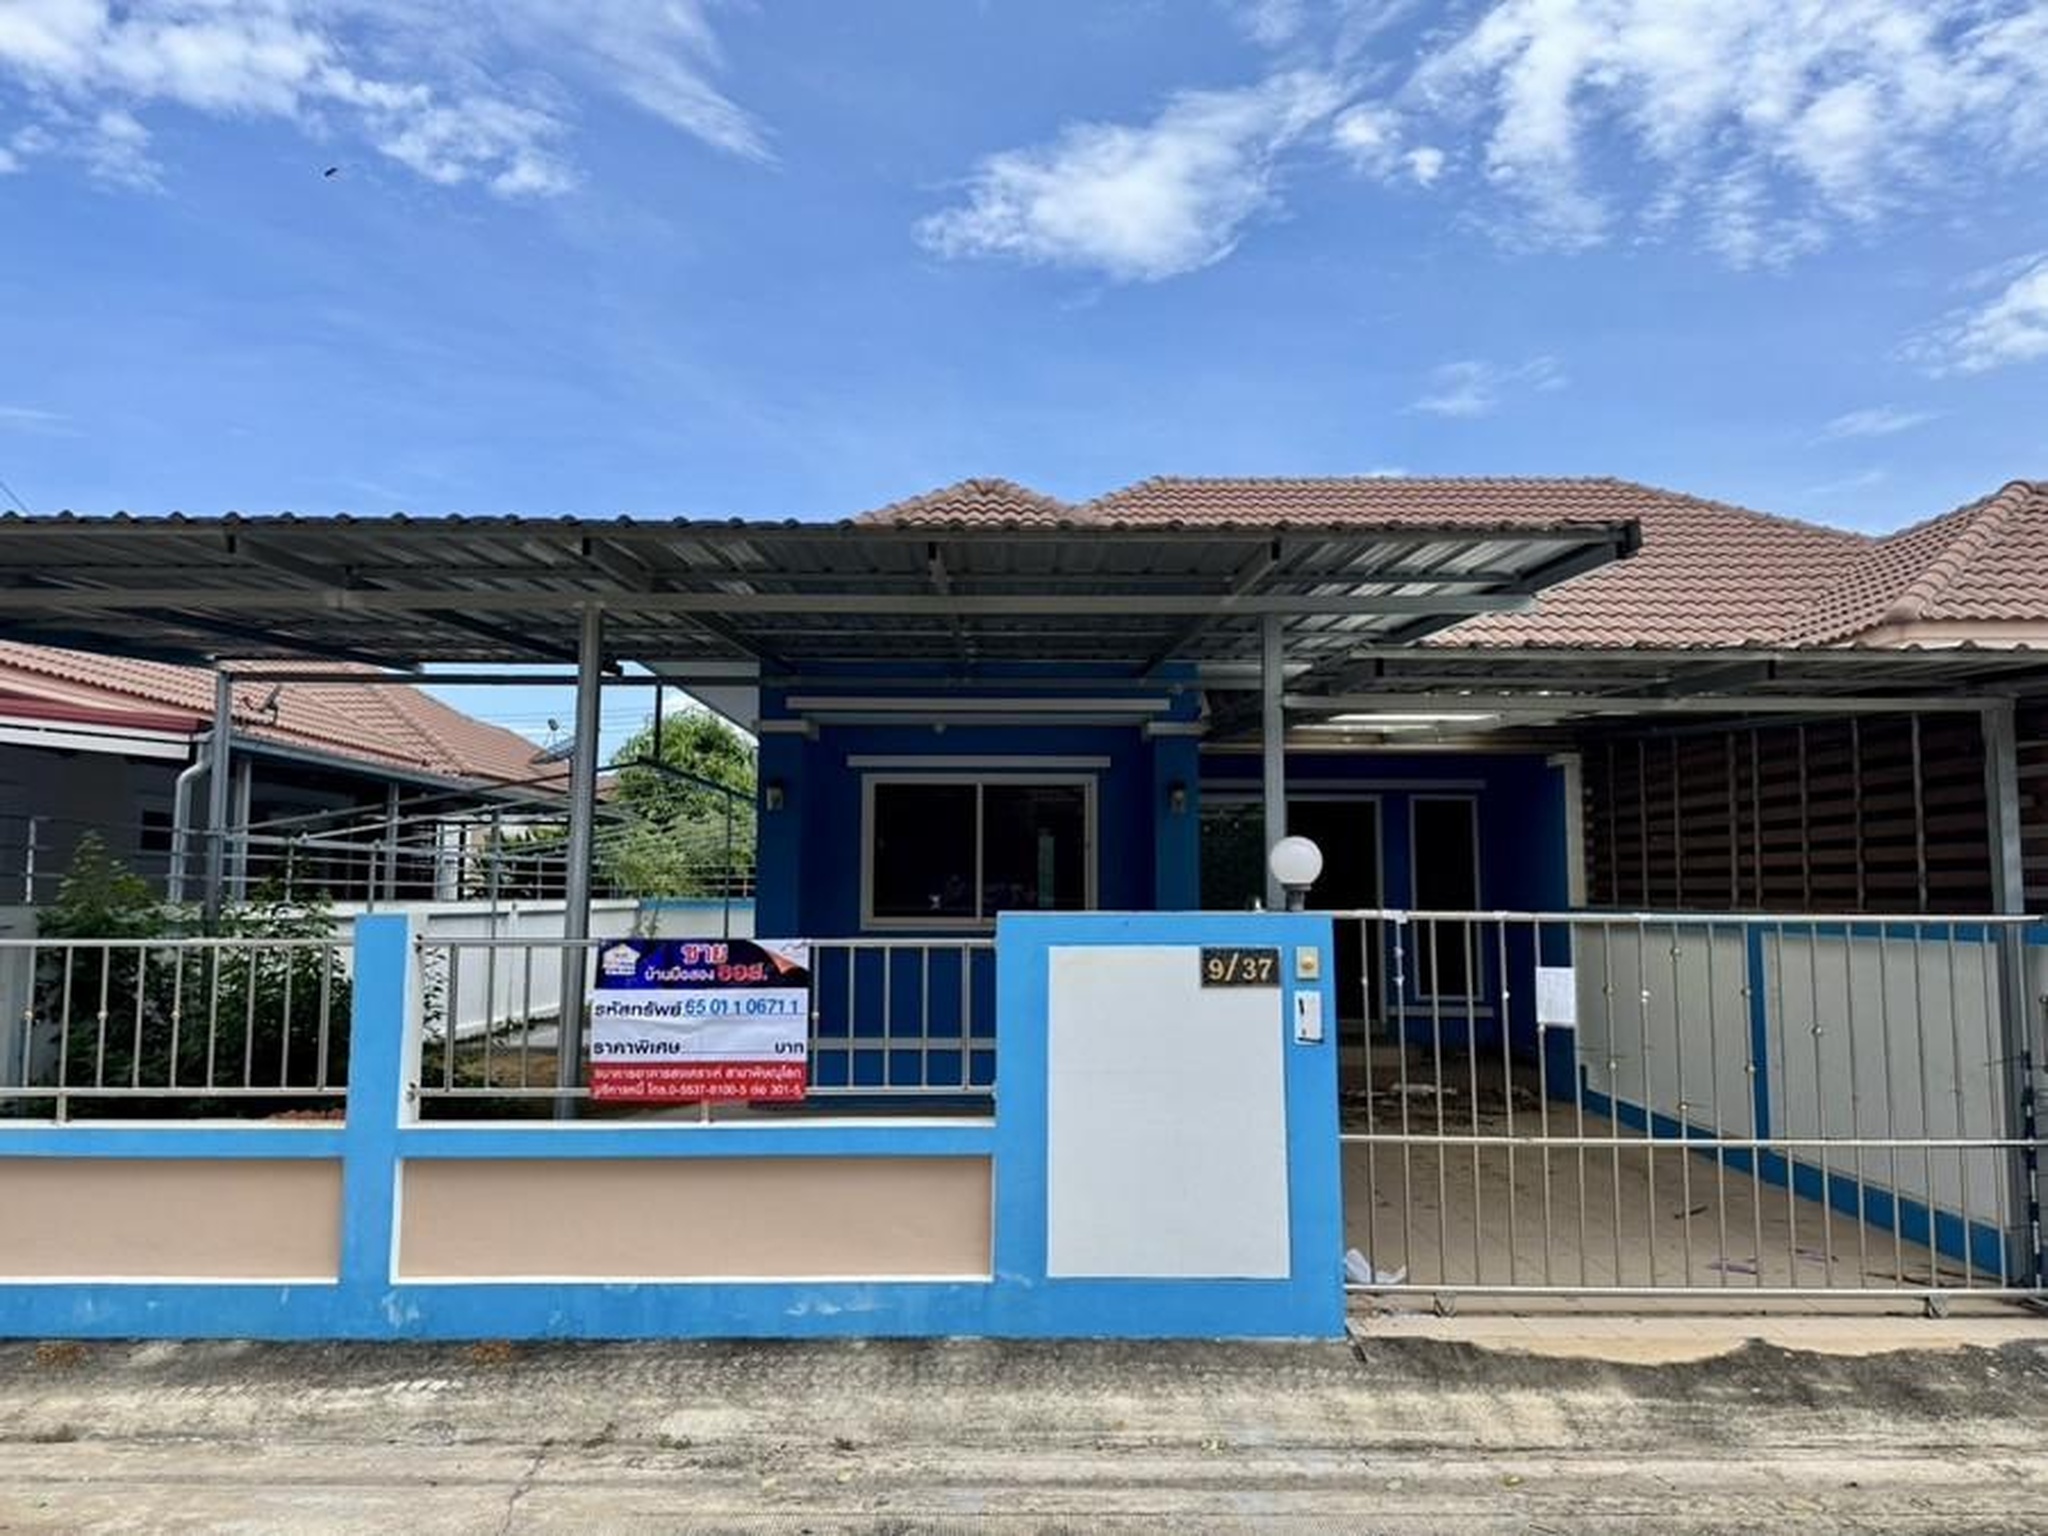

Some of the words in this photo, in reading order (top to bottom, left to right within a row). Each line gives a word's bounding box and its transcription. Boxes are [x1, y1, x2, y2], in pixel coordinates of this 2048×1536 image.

[680, 943, 729, 963] ขาย
[645, 965, 714, 982] บ้านมือสอง
[1208, 952, 1273, 981] 9/37
[594, 998, 682, 1017] รหัสทรัพย์
[593, 1039, 681, 1055] ราคาพิเศษ
[775, 1041, 804, 1054] บาท
